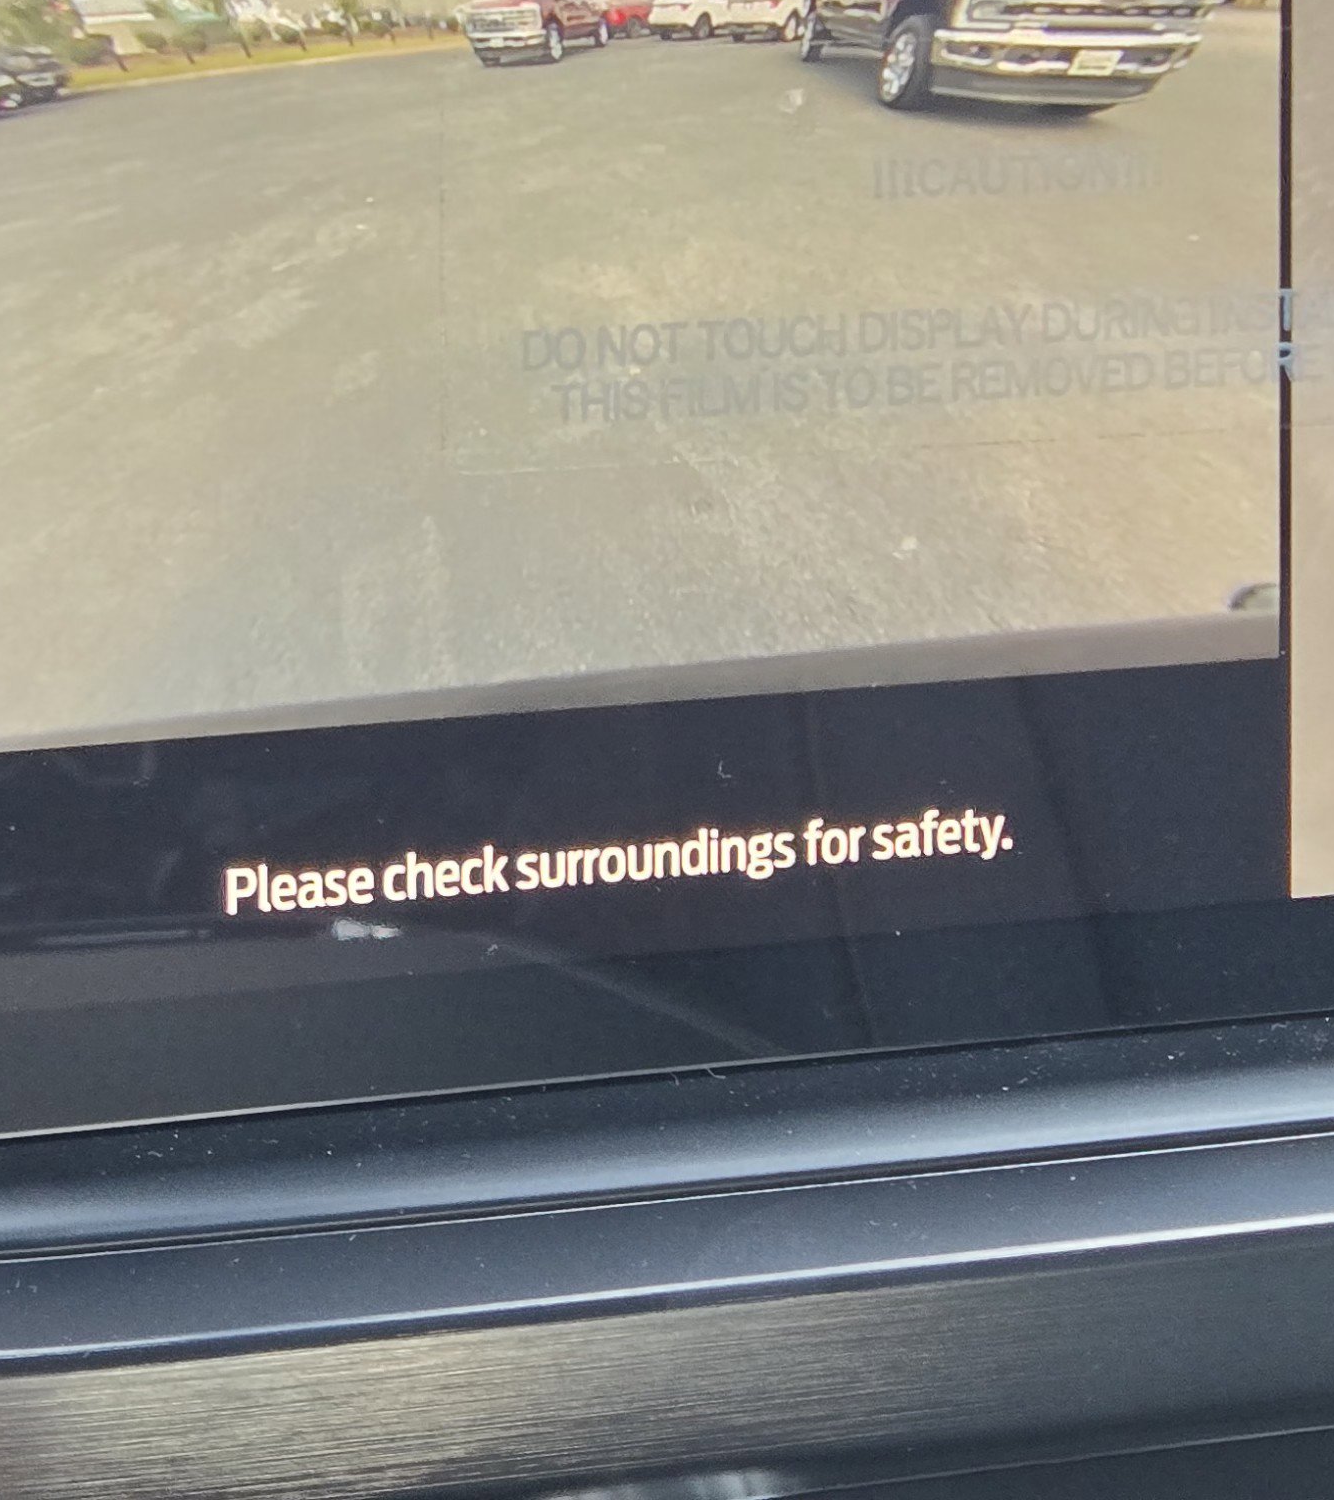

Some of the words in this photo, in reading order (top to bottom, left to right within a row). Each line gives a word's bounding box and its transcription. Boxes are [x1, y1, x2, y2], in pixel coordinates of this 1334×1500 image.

[522, 326, 587, 372] DO
[597, 321, 689, 369] NOT
[697, 312, 848, 362] TOUCH
[858, 303, 1034, 353] DISPLAY
[1042, 296, 1201, 344] DURING
[550, 379, 650, 425] THIS
[659, 373, 762, 421] FILM
[772, 371, 812, 414] IS
[820, 366, 879, 410] TO
[886, 363, 945, 407] BE
[951, 351, 1157, 404] REMOVED
[1163, 340, 1323, 391] BEFORE
[225, 862, 375, 916] Please
[382, 844, 510, 902] check
[514, 827, 797, 880] surroundings
[802, 817, 867, 867] for
[871, 808, 1014, 861] safety.
